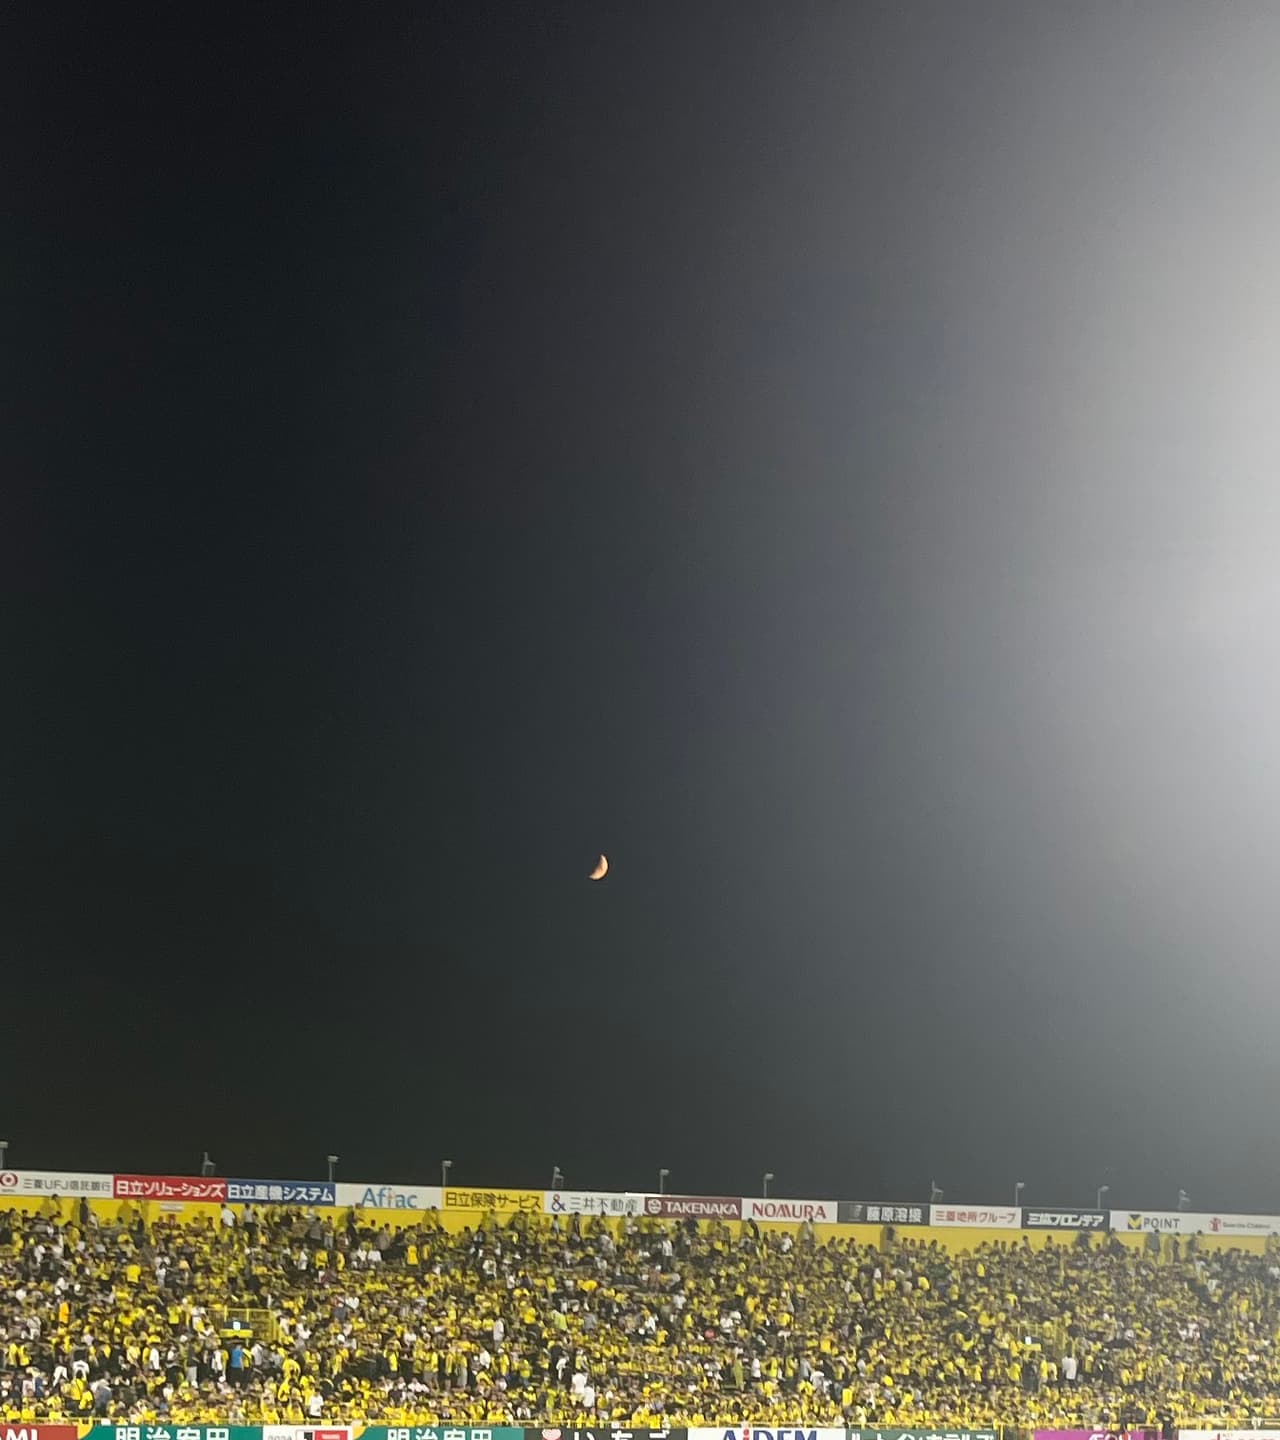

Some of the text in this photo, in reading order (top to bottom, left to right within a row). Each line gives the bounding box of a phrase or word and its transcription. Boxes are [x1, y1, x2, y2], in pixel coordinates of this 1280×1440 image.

[116, 1180, 225, 1198] 日立ソリューションズ
[227, 1184, 334, 1202] 日立産機システム
[361, 1186, 418, 1208] Aflac
[445, 1191, 541, 1210] 日立保険サービス
[570, 1196, 638, 1212] 三井不動産
[666, 1201, 738, 1216] TAKENAKA
[752, 1202, 827, 1219] NOMURA
[1143, 1216, 1180, 1229] POINT
